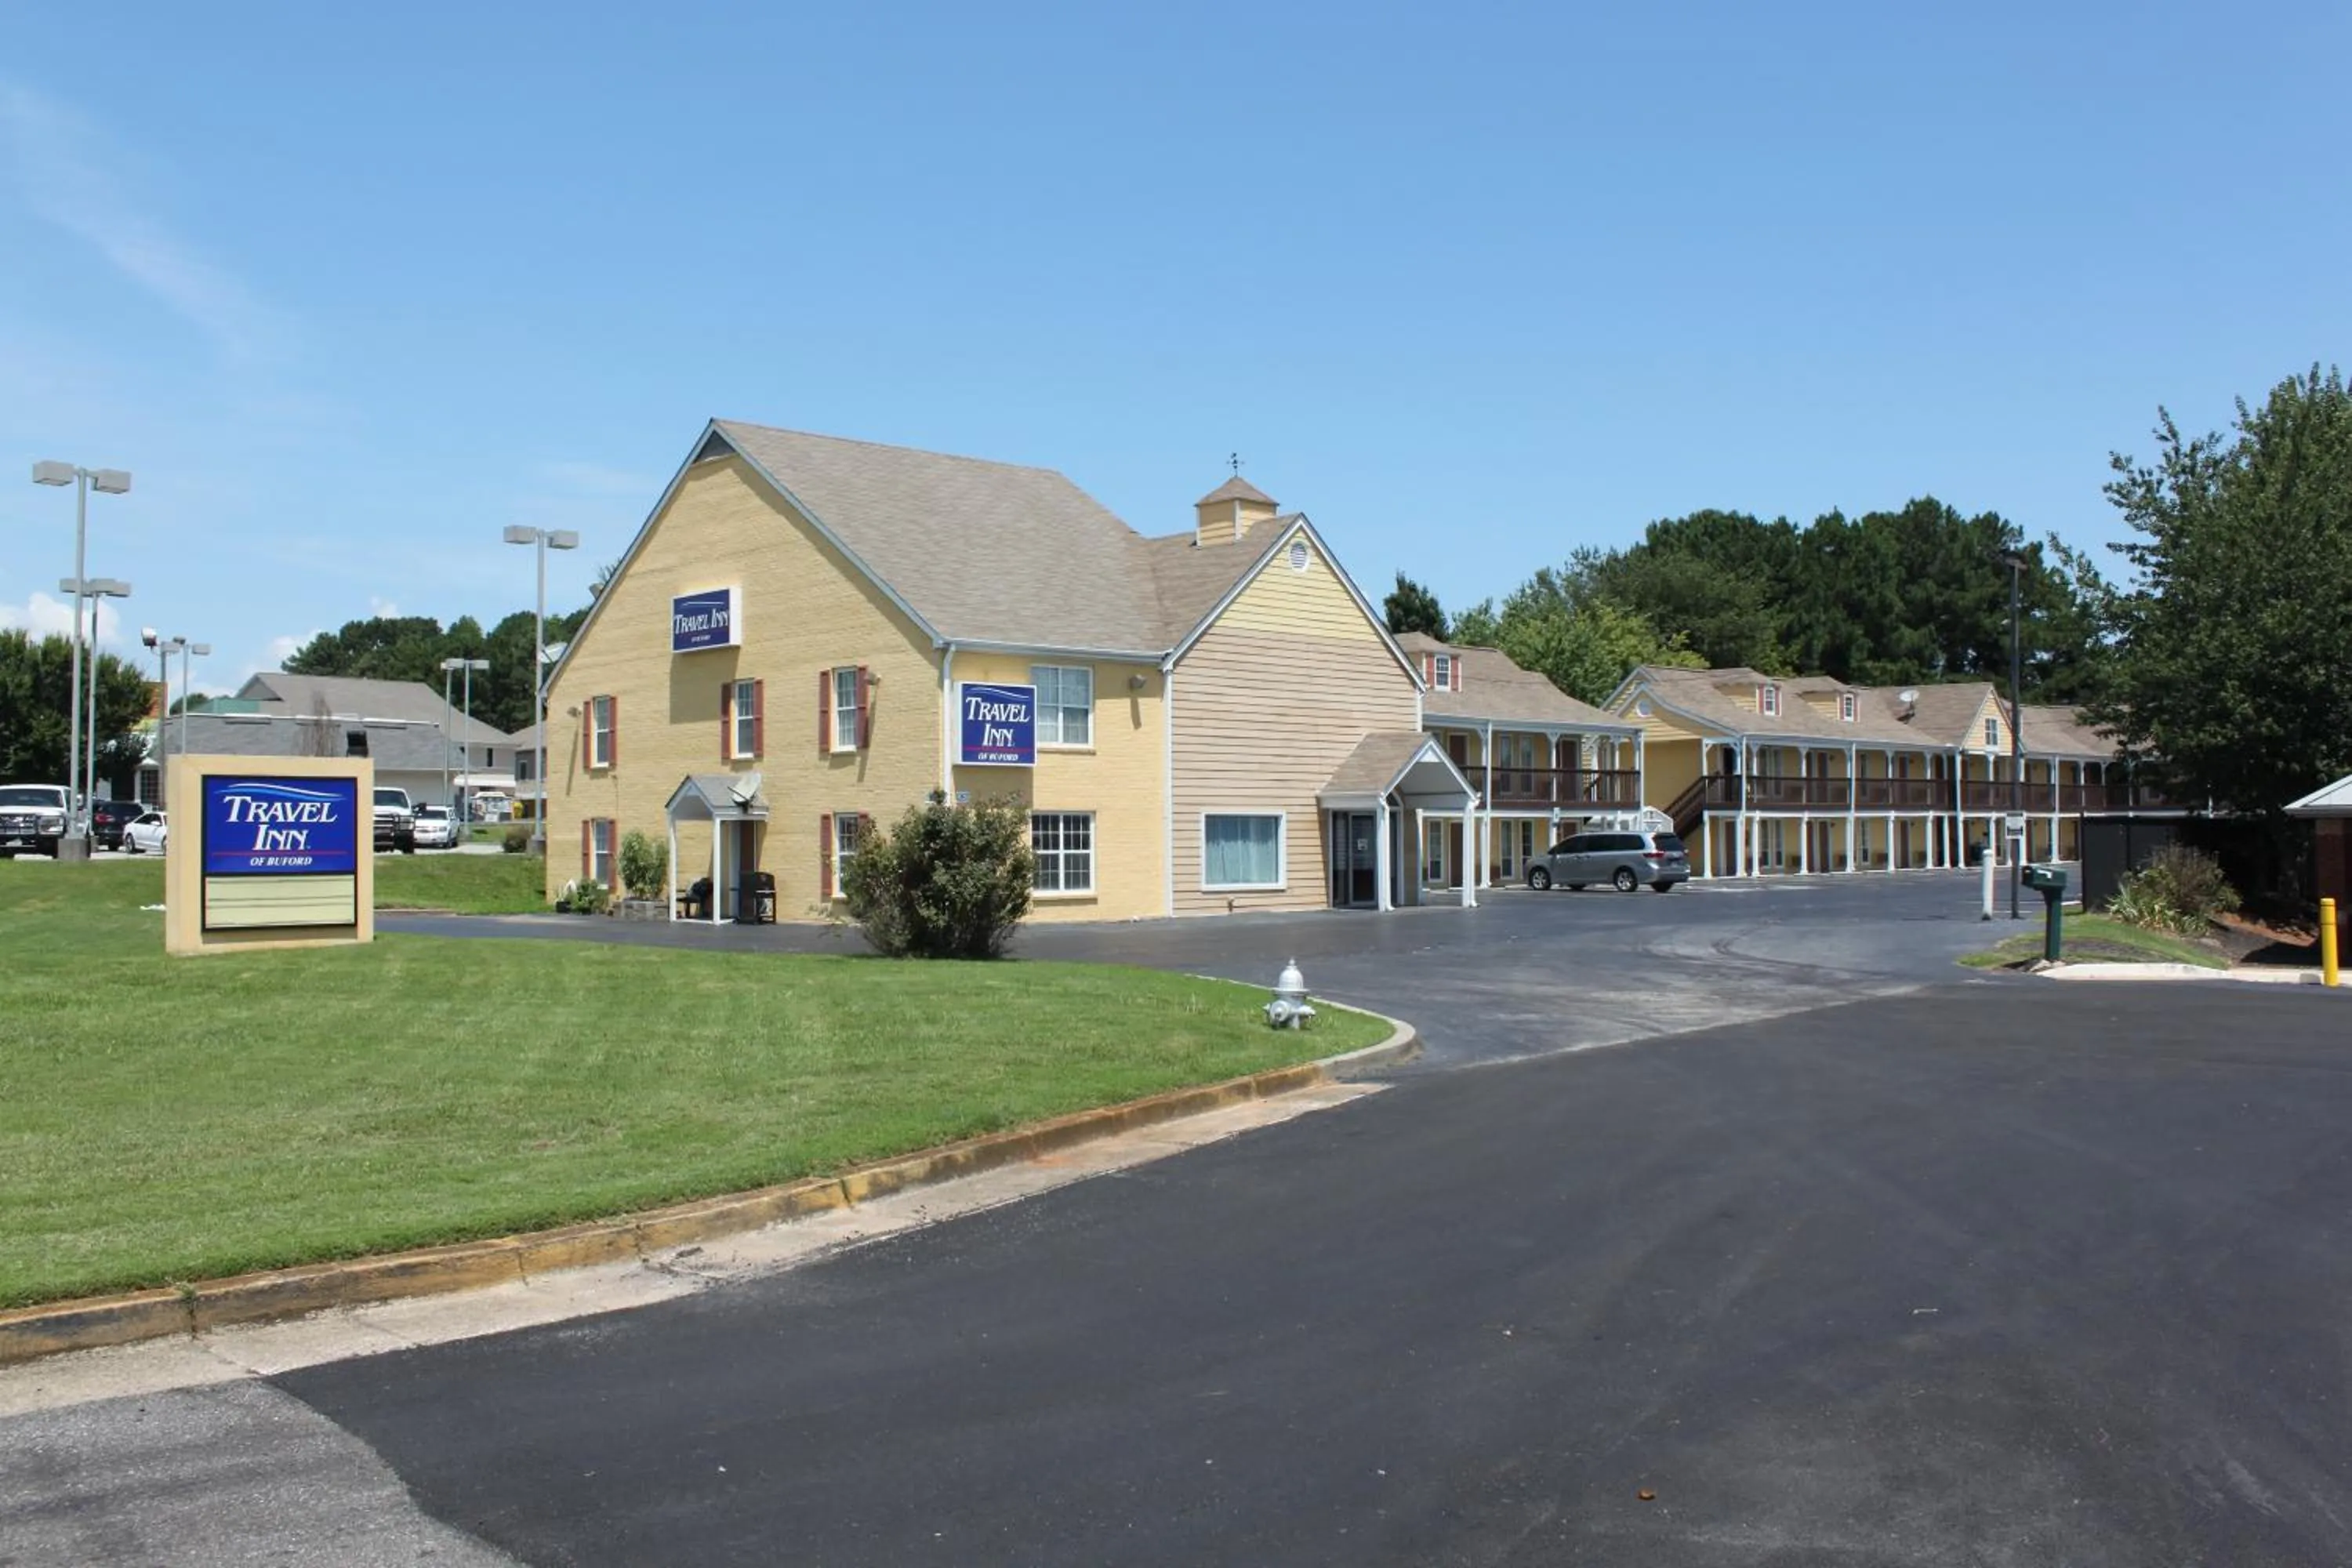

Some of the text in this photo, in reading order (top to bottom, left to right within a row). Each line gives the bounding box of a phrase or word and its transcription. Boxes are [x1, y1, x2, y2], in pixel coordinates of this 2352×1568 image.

[965, 696, 1031, 721] TRAVEL
[982, 723, 1014, 747] INN
[223, 795, 338, 822] TRAVEL
[252, 824, 309, 851] INN
[250, 856, 313, 866] OF BUFORD
